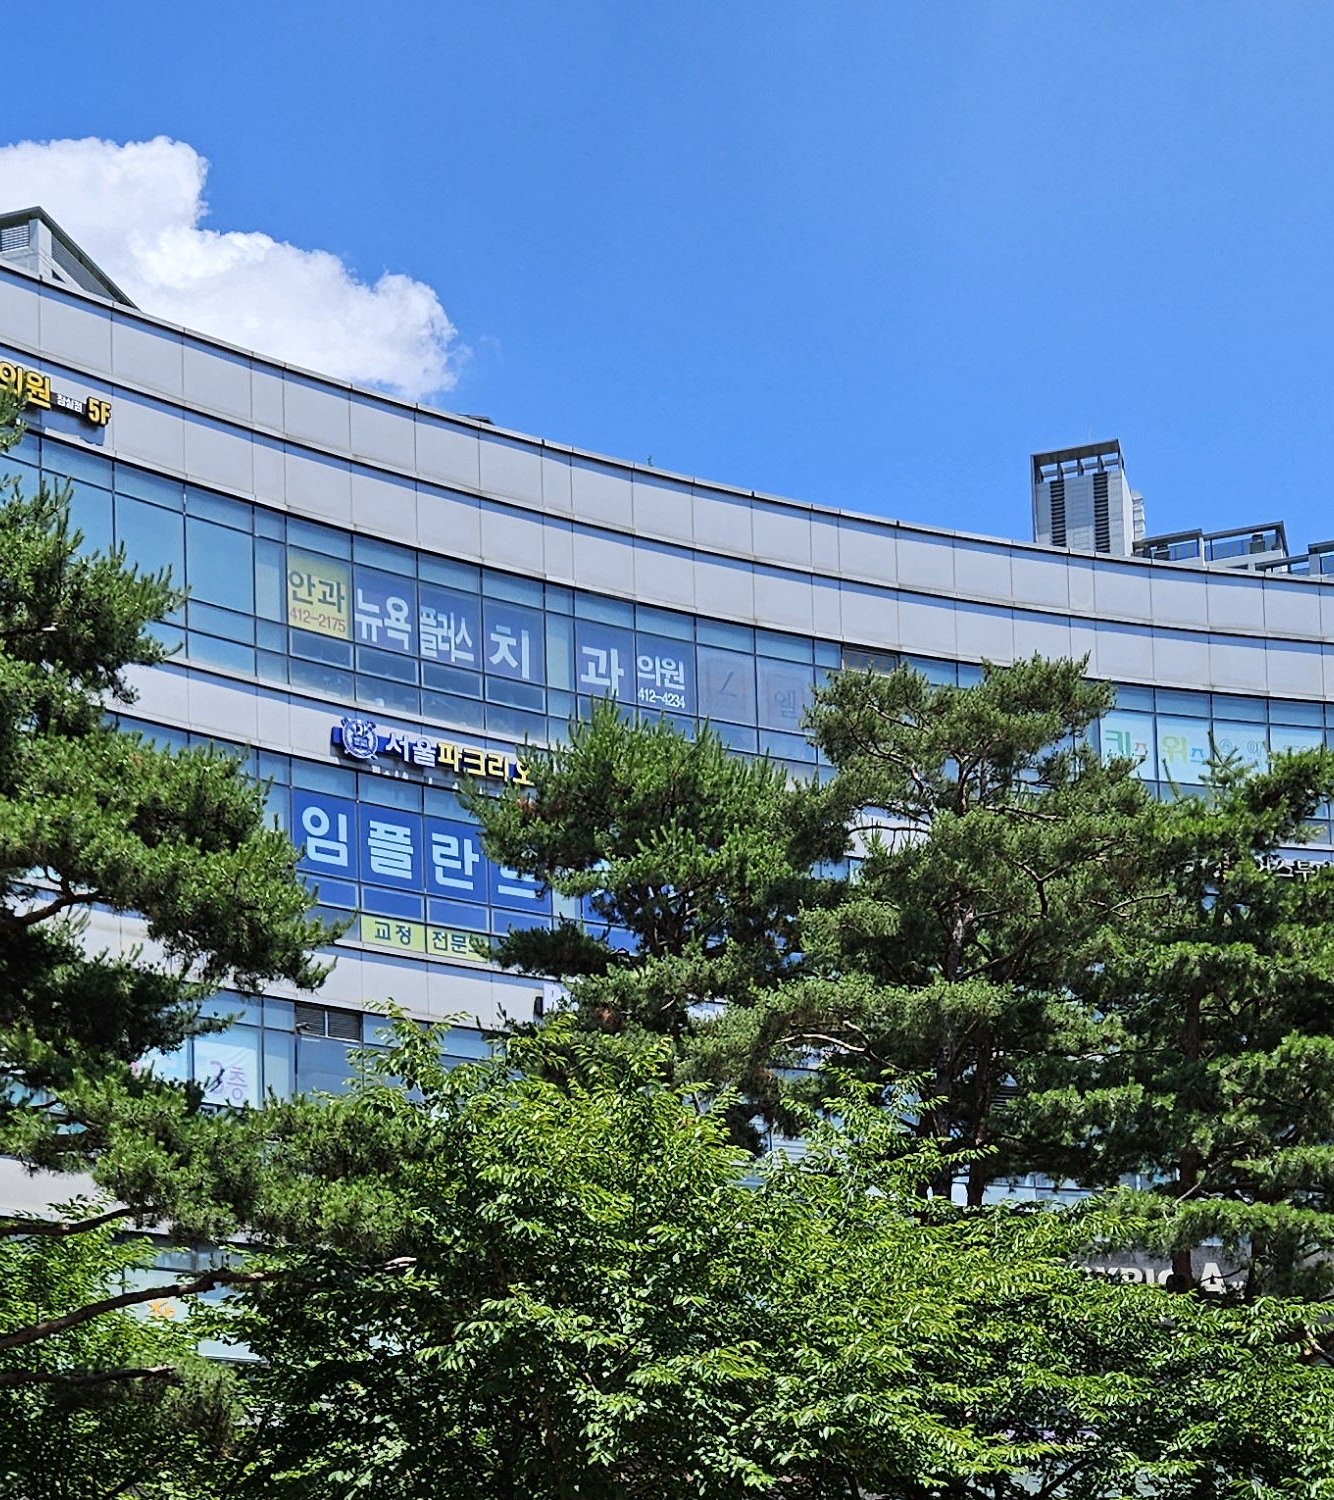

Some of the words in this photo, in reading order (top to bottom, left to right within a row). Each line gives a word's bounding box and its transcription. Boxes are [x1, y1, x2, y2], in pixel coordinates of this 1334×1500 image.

[88, 397, 112, 425] 5F
[289, 571, 345, 614] 안과
[290, 607, 347, 633] 412-2175
[637, 687, 686, 709] 412-4234
[374, 920, 412, 946] 교정
